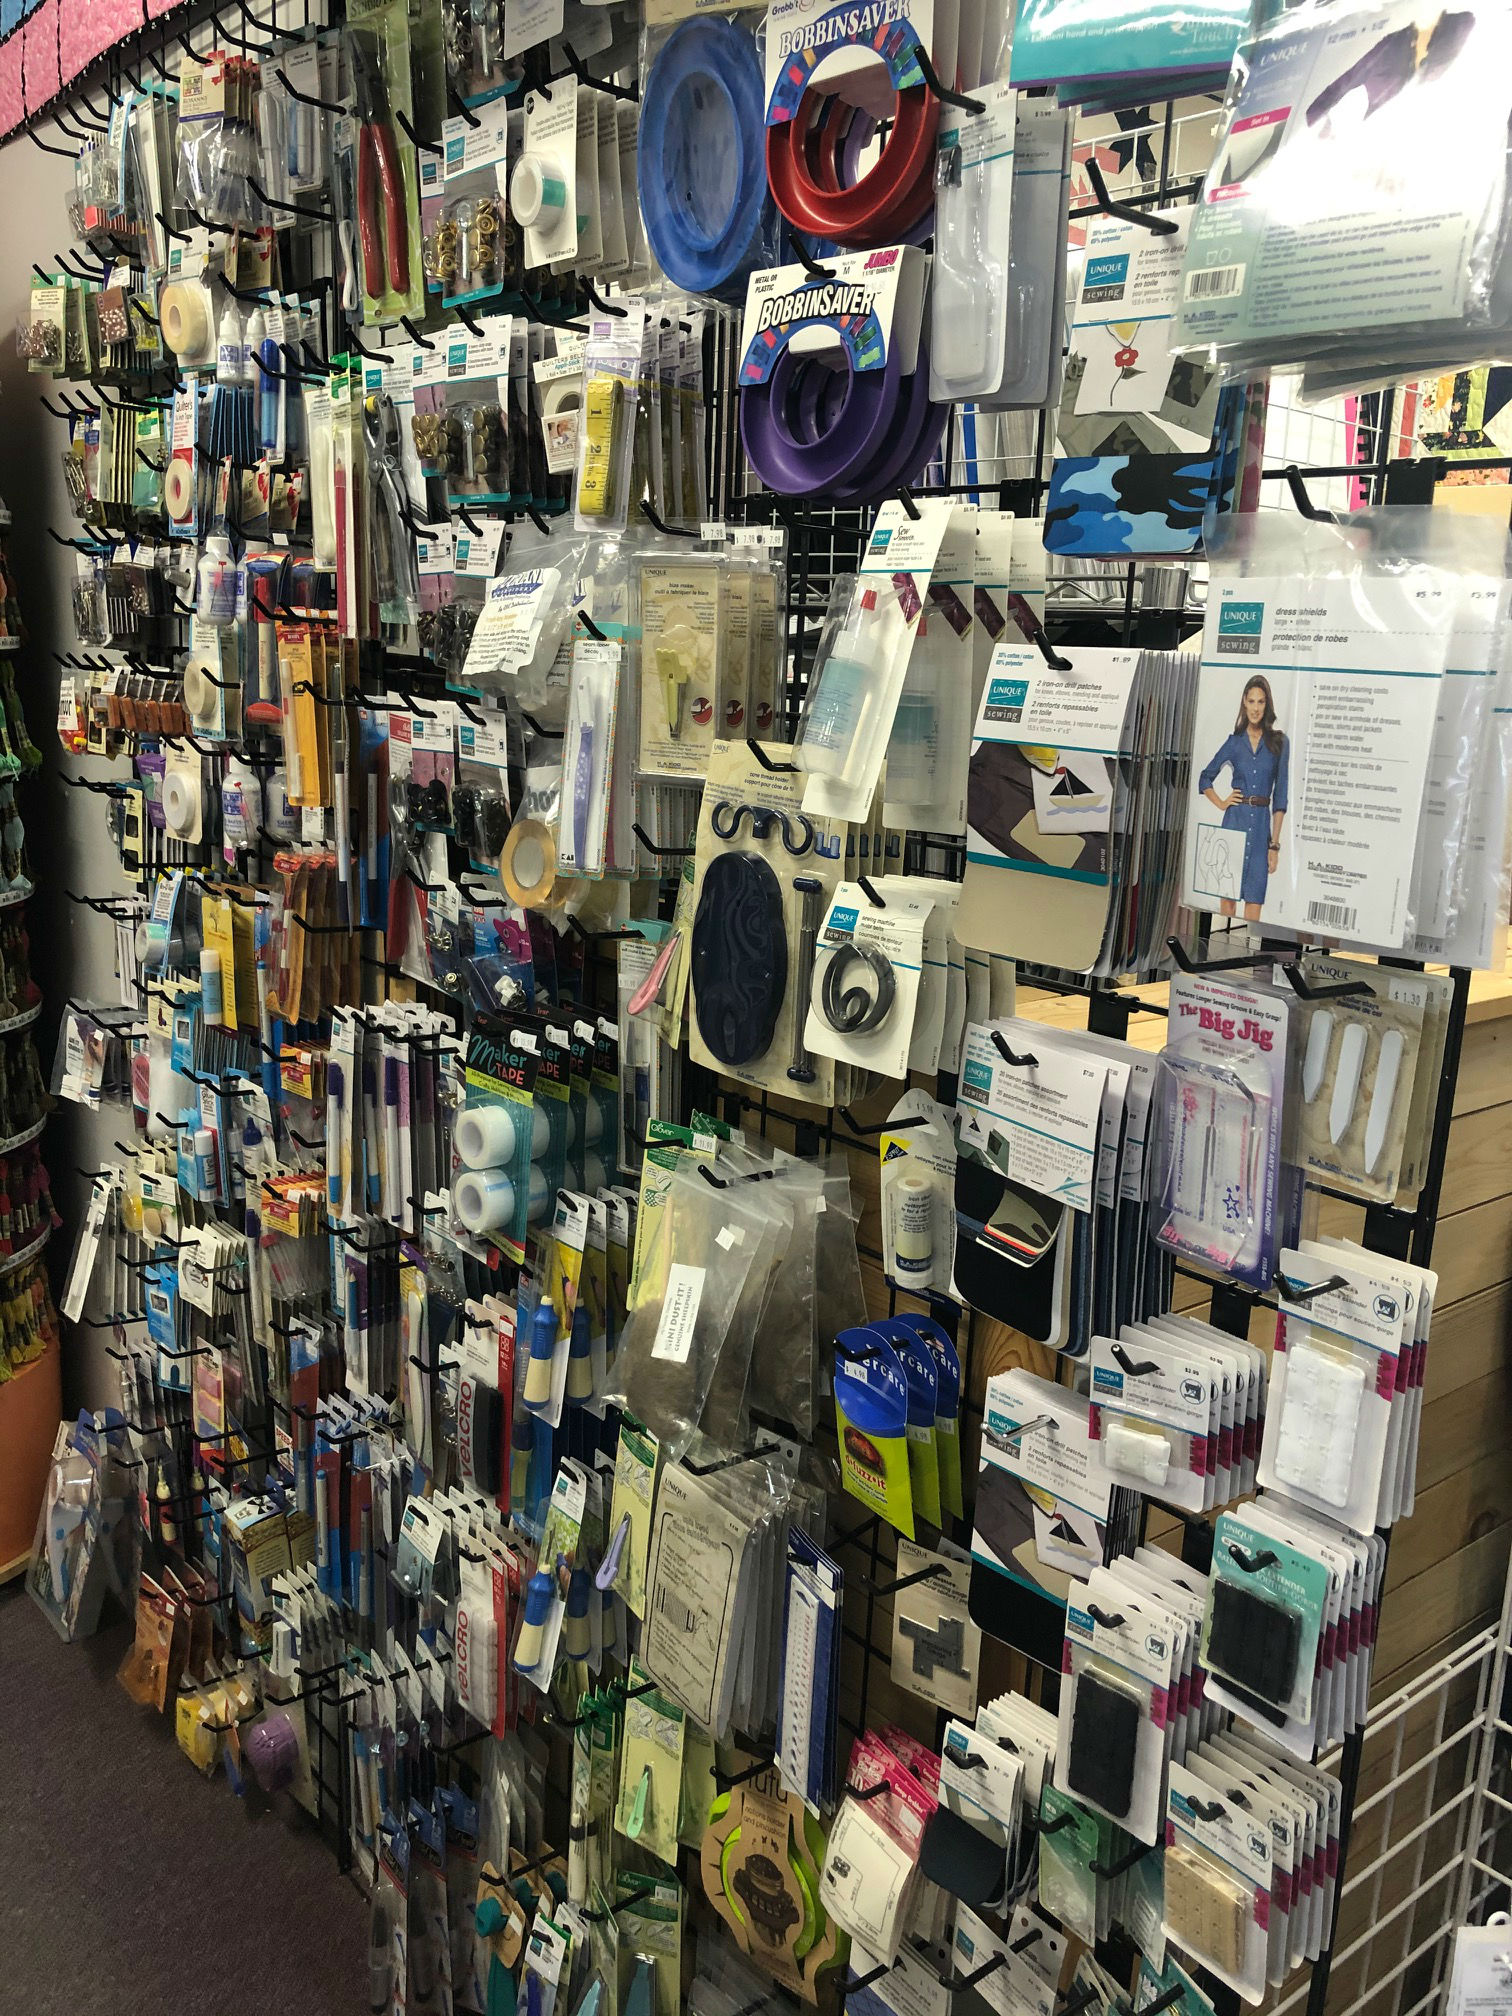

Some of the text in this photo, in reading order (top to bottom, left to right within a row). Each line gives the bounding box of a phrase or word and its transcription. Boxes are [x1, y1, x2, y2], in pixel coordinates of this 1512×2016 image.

[779, 0, 910, 58] BOBBINSAVER
[1145, 248, 1169, 256] iron-on
[864, 249, 899, 270] JUMBO
[876, 266, 895, 275] DIAMETER
[1090, 262, 1122, 275] UNIQUE
[755, 274, 778, 284] METAL OR
[1141, 270, 1167, 279] renforts
[755, 284, 774, 293] PLASTIC
[1142, 280, 1158, 288] toile
[1087, 288, 1120, 299] sewing
[757, 283, 876, 334] BOBBINSAVER
[591, 445, 601, 453] 2
[585, 480, 596, 488] 3
[1224, 611, 1257, 622] UNIQUE
[1299, 608, 1327, 616] shields
[1272, 634, 1311, 642] protection
[1221, 639, 1255, 653] sewing
[993, 686, 1022, 695] UNIQUE
[1077, 683, 1102, 691] patches
[1062, 703, 1099, 712] repassables
[987, 709, 1018, 721] sewing
[833, 911, 855, 922] UNIQUE
[1311, 963, 1351, 980] UNIQUE
[1211, 988, 1237, 998] IMPROVED
[1176, 989, 1195, 999] Features
[1196, 993, 1212, 1004] Longer
[1213, 998, 1229, 1009] Sewing
[1179, 1003, 1274, 1051] The Big Jig
[496, 1062, 525, 1085] TAPE
[651, 1123, 674, 1135] Clover
[664, 1477, 689, 1500] UNIQUE
[1223, 1522, 1254, 1544] UNIQUE
